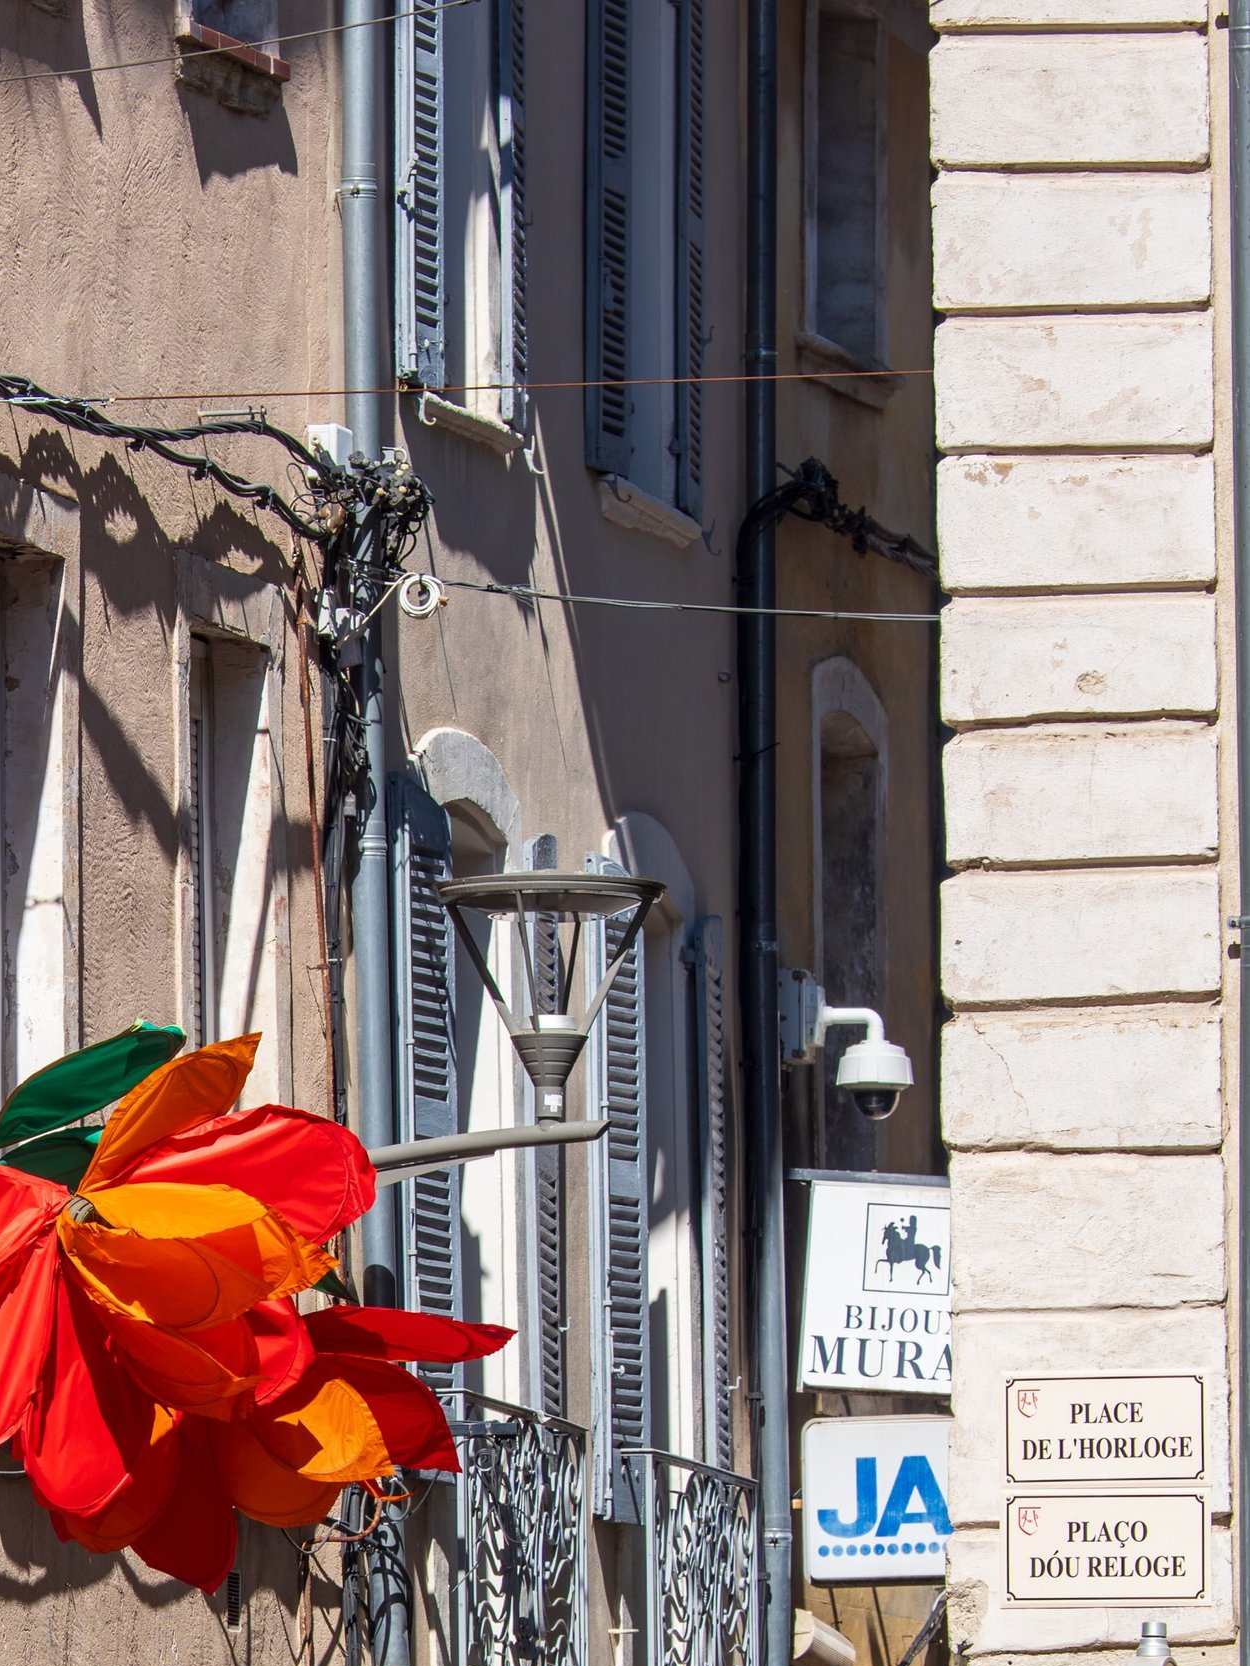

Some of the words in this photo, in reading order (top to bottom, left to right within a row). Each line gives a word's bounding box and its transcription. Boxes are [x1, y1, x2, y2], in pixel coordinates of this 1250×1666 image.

[844, 1304, 952, 1335] BIJOU
[1069, 1401, 1144, 1424] PLACE
[1021, 1439, 1053, 1460] DE
[1057, 1436, 1194, 1460] L'HORLOGE
[817, 1455, 954, 1539] JA
[1066, 1520, 1148, 1548] PLAÇO
[1029, 1550, 1080, 1579] DÓU
[1087, 1555, 1187, 1578] RELOGE
